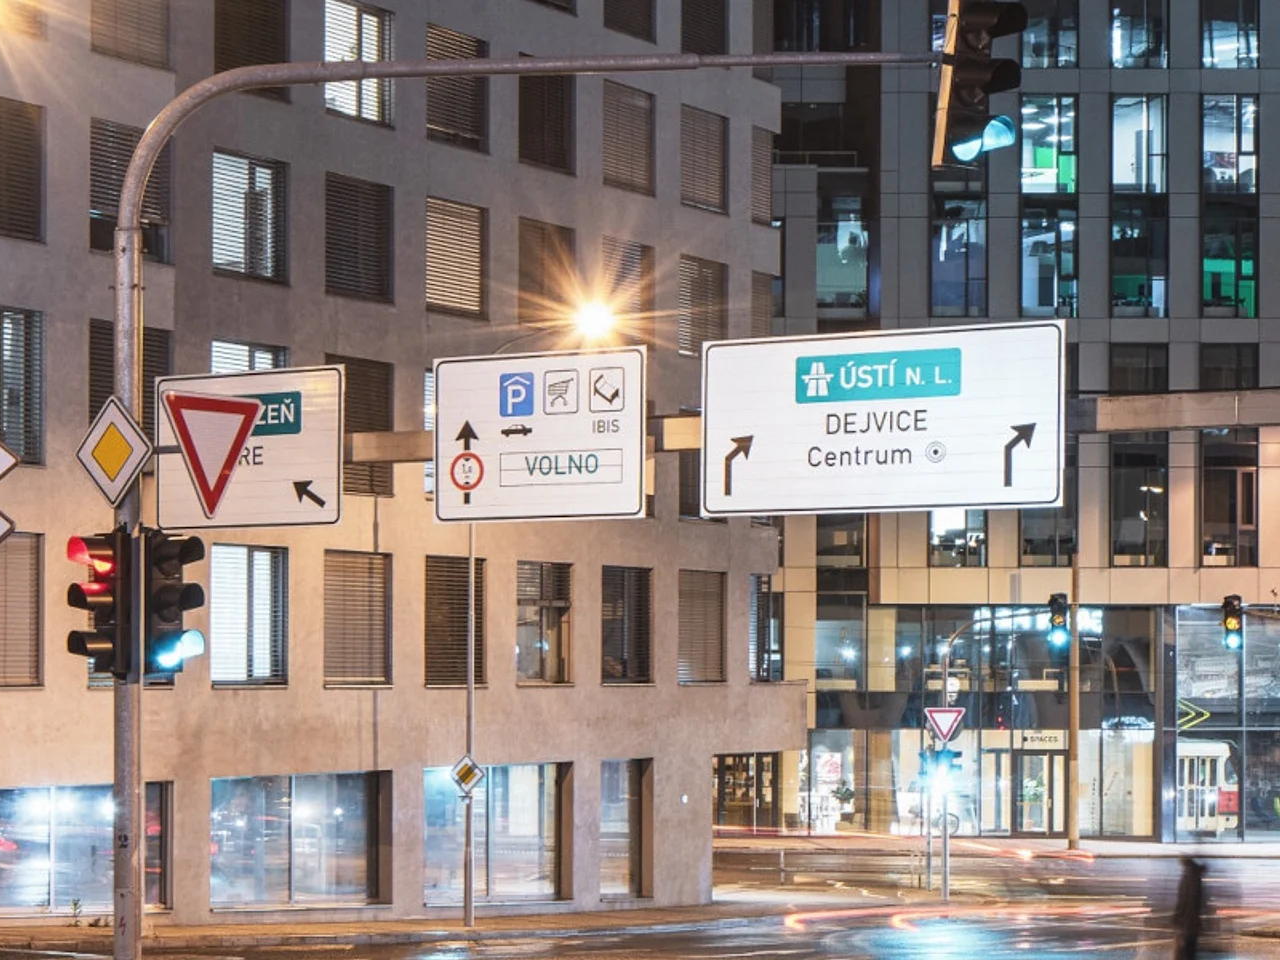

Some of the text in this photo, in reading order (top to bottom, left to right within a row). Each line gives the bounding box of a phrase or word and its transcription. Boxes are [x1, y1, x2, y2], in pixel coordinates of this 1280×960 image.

[839, 359, 953, 389] ÚSTÍ N. L.
[254, 398, 295, 425] ZEŇ
[825, 409, 928, 435] DEJVICE
[592, 419, 620, 434] IBIS
[238, 445, 264, 466] RE
[524, 452, 599, 477] VOLNO
[807, 445, 912, 468] Centrum
